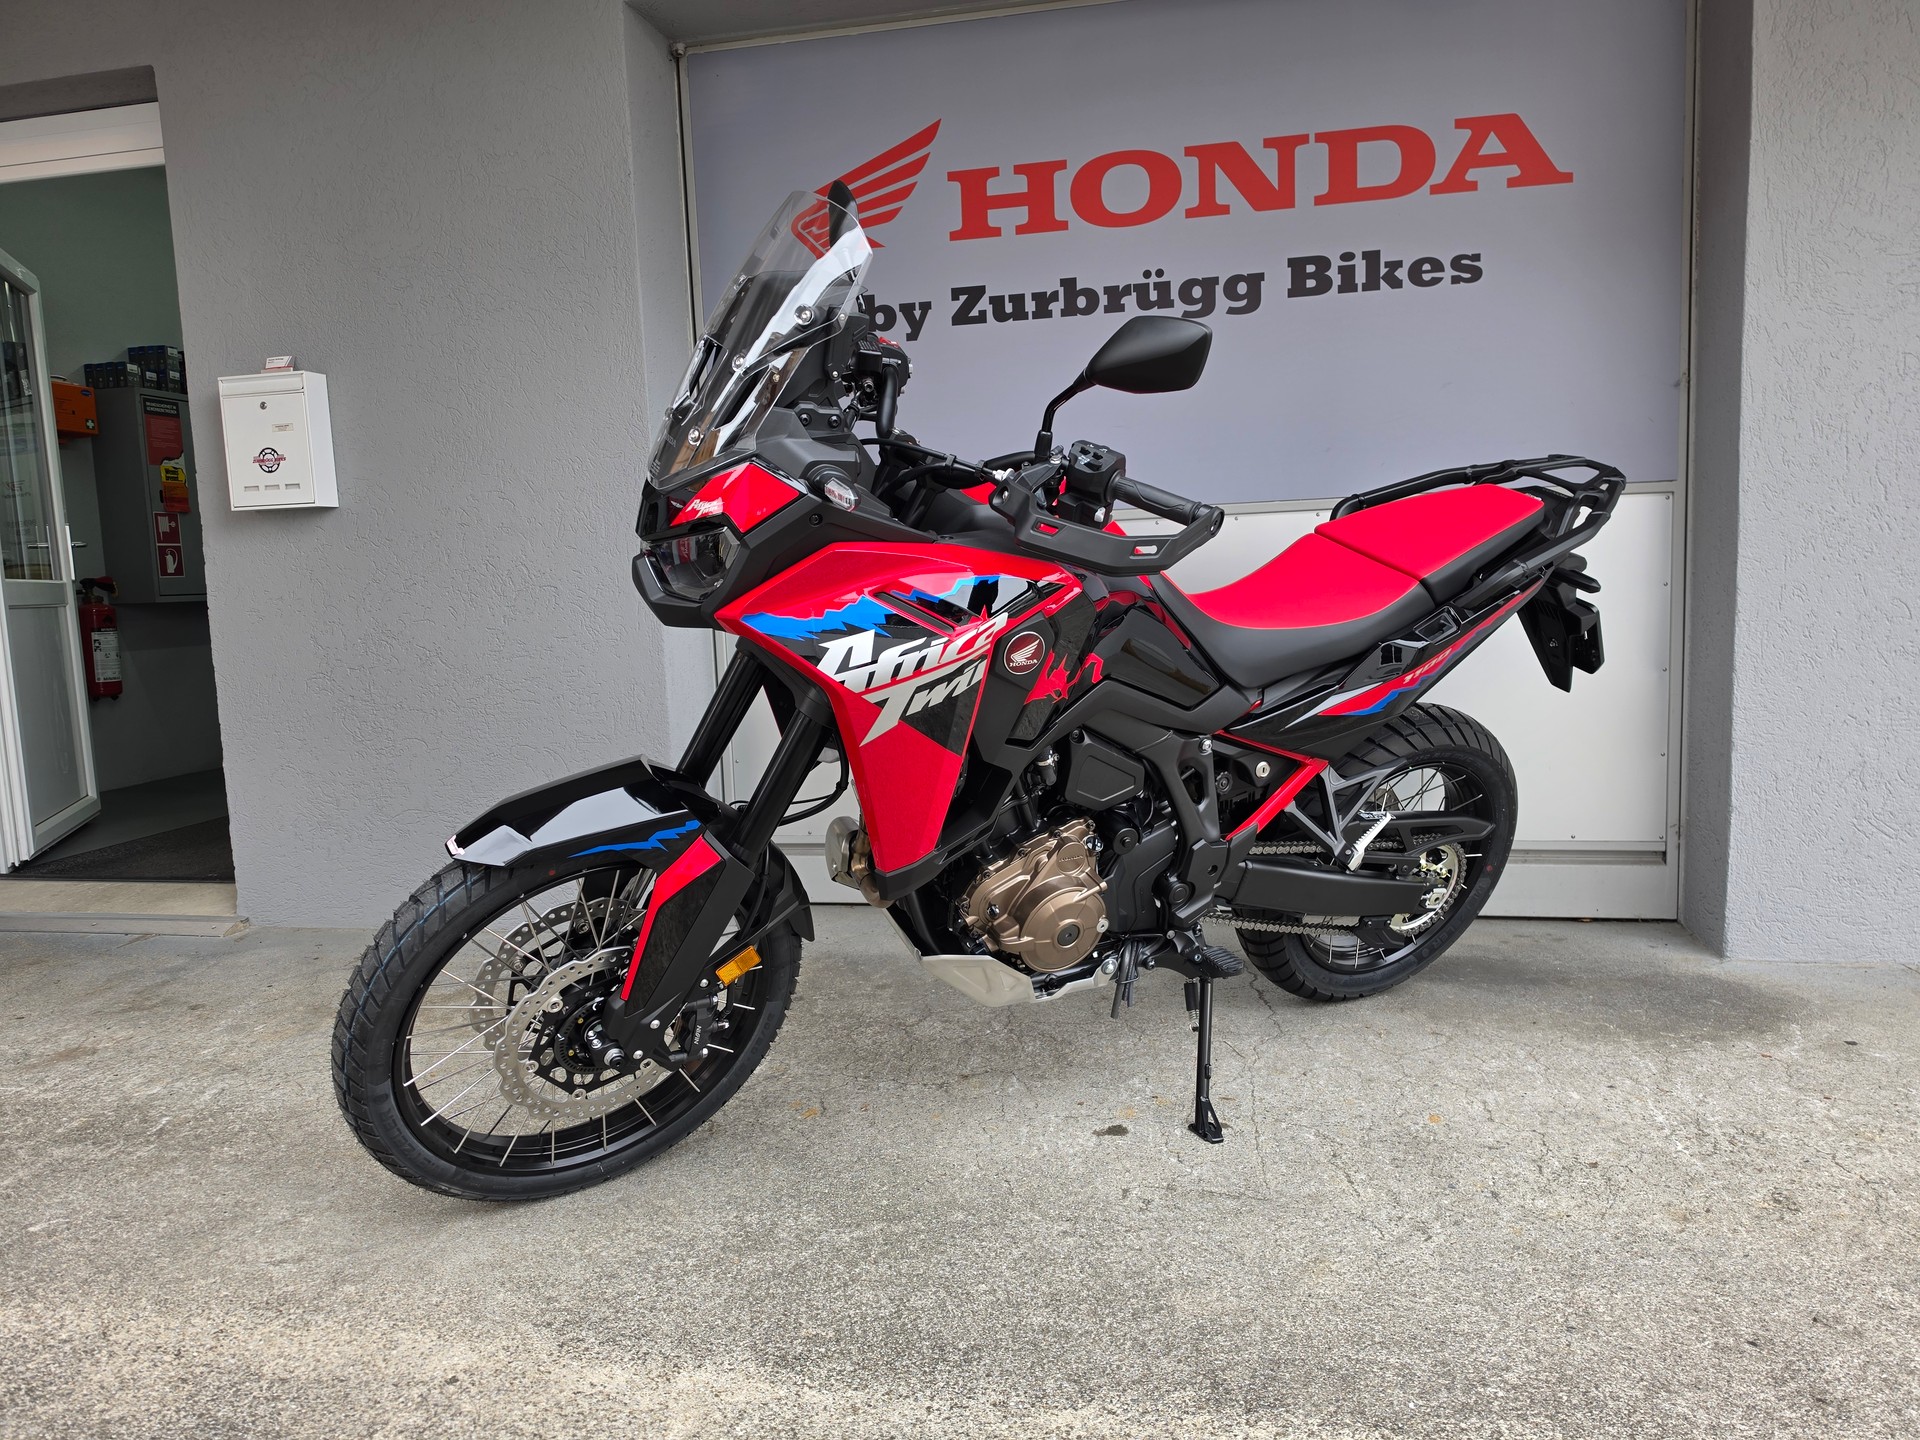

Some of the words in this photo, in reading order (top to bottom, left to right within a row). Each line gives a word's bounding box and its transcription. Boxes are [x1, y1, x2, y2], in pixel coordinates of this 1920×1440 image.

[948, 113, 1573, 241] HONDA
[864, 294, 932, 341] by
[951, 270, 1265, 326] Zurbrügg
[1287, 249, 1484, 298] Bikes
[816, 612, 1009, 694] Africa
[1009, 659, 1038, 668] HONDA
[1402, 647, 1453, 685] 1100
